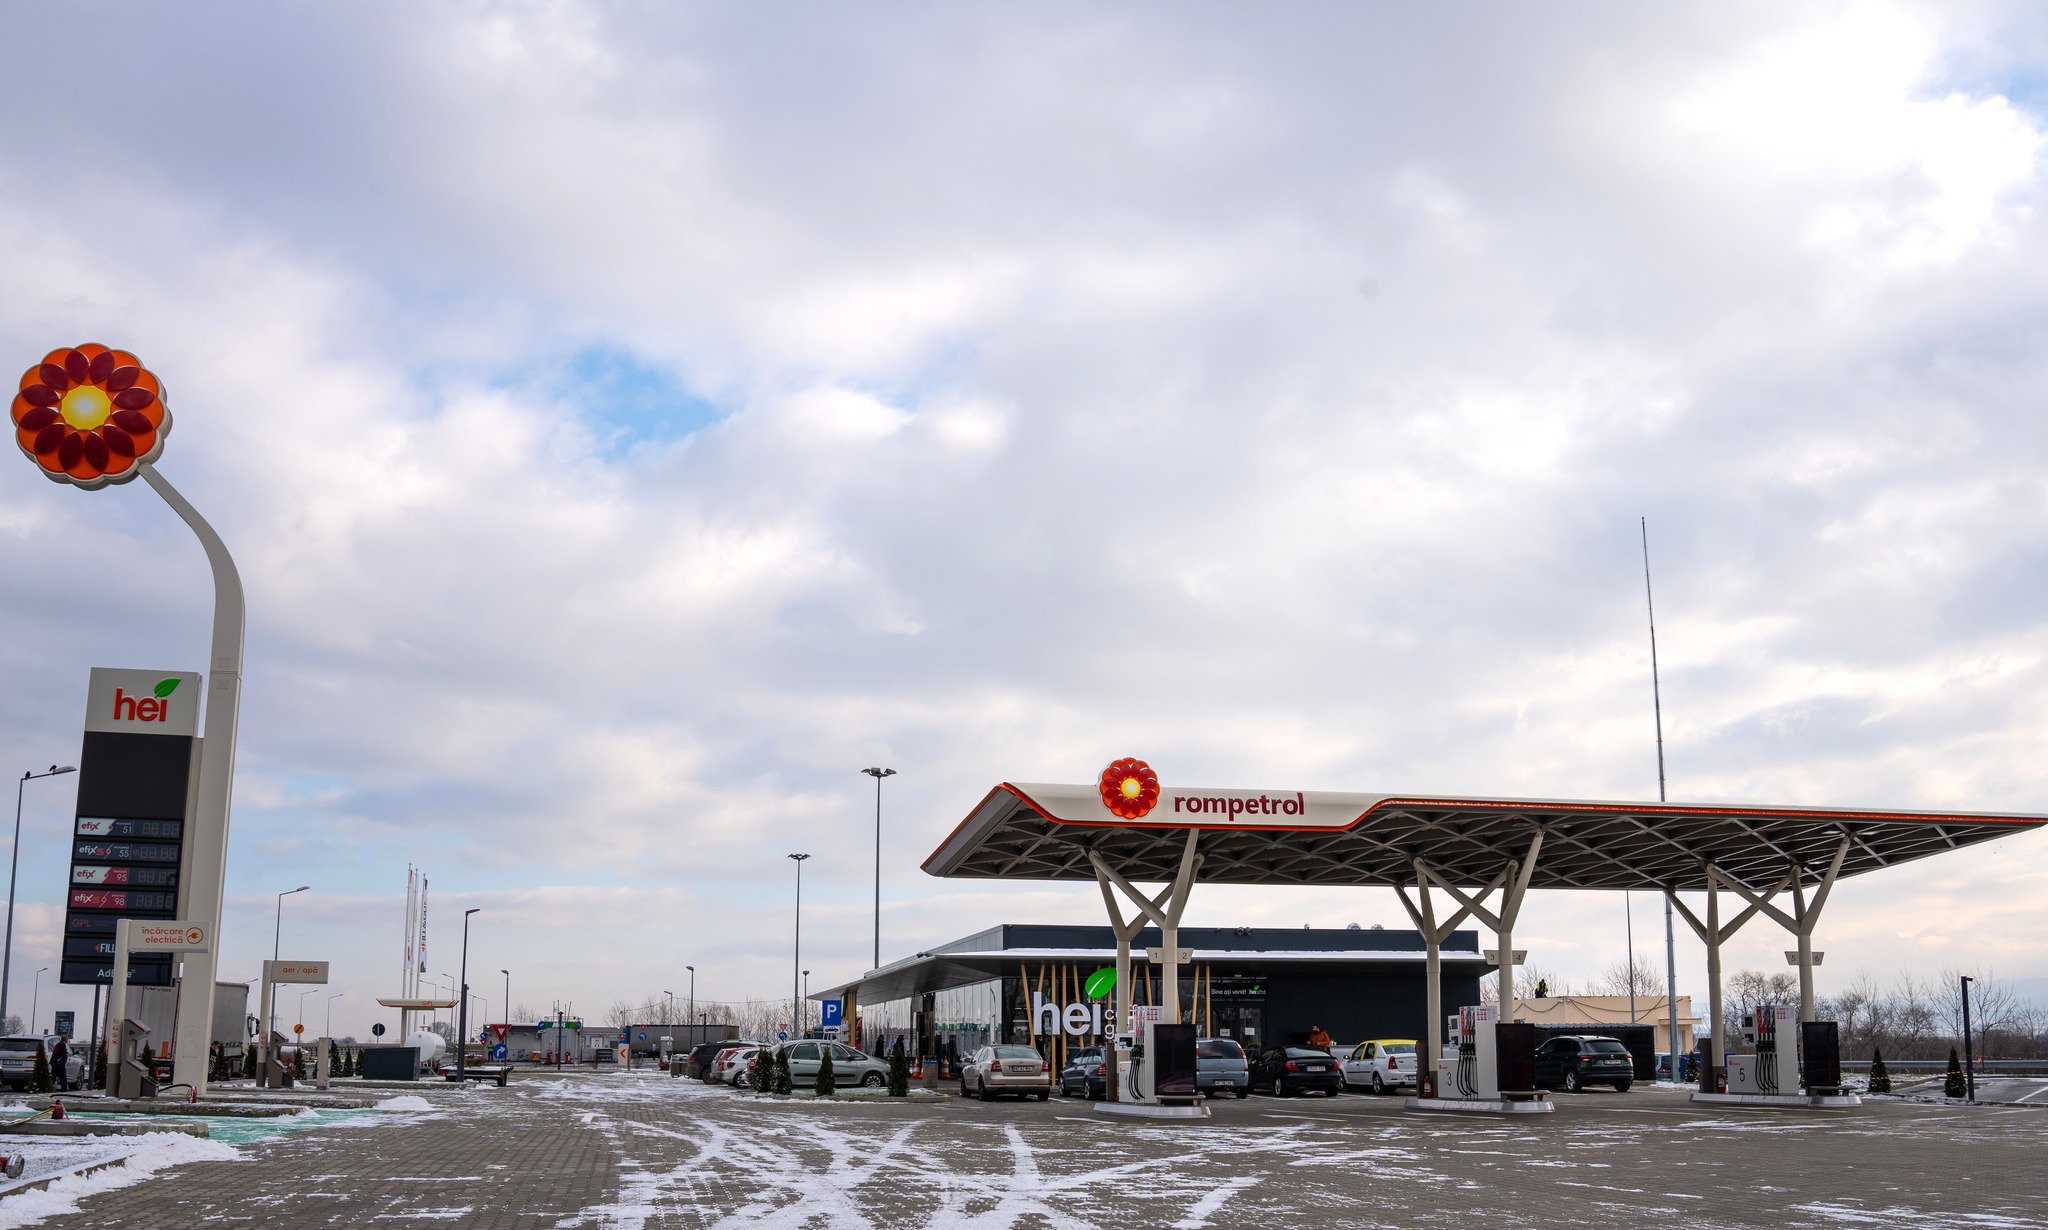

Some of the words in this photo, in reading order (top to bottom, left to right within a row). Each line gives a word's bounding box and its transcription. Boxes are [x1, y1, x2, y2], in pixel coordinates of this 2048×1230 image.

[113, 686, 168, 722] hei
[1174, 792, 1305, 821] rompetrol
[81, 821, 101, 831] efix
[122, 826, 132, 834] 51
[118, 849, 130, 858] 55
[76, 869, 97, 880] efix
[116, 873, 127, 882] 95
[114, 897, 126, 906] 98
[72, 918, 92, 928] GPL
[1182, 952, 1188, 960] 2
[1490, 953, 1495, 961] 3
[1791, 954, 1796, 962] 5
[826, 1003, 838, 1019] P
[1033, 991, 1102, 1036] hei
[1446, 1071, 1453, 1087] 3
[1739, 1067, 1746, 1082] 5
